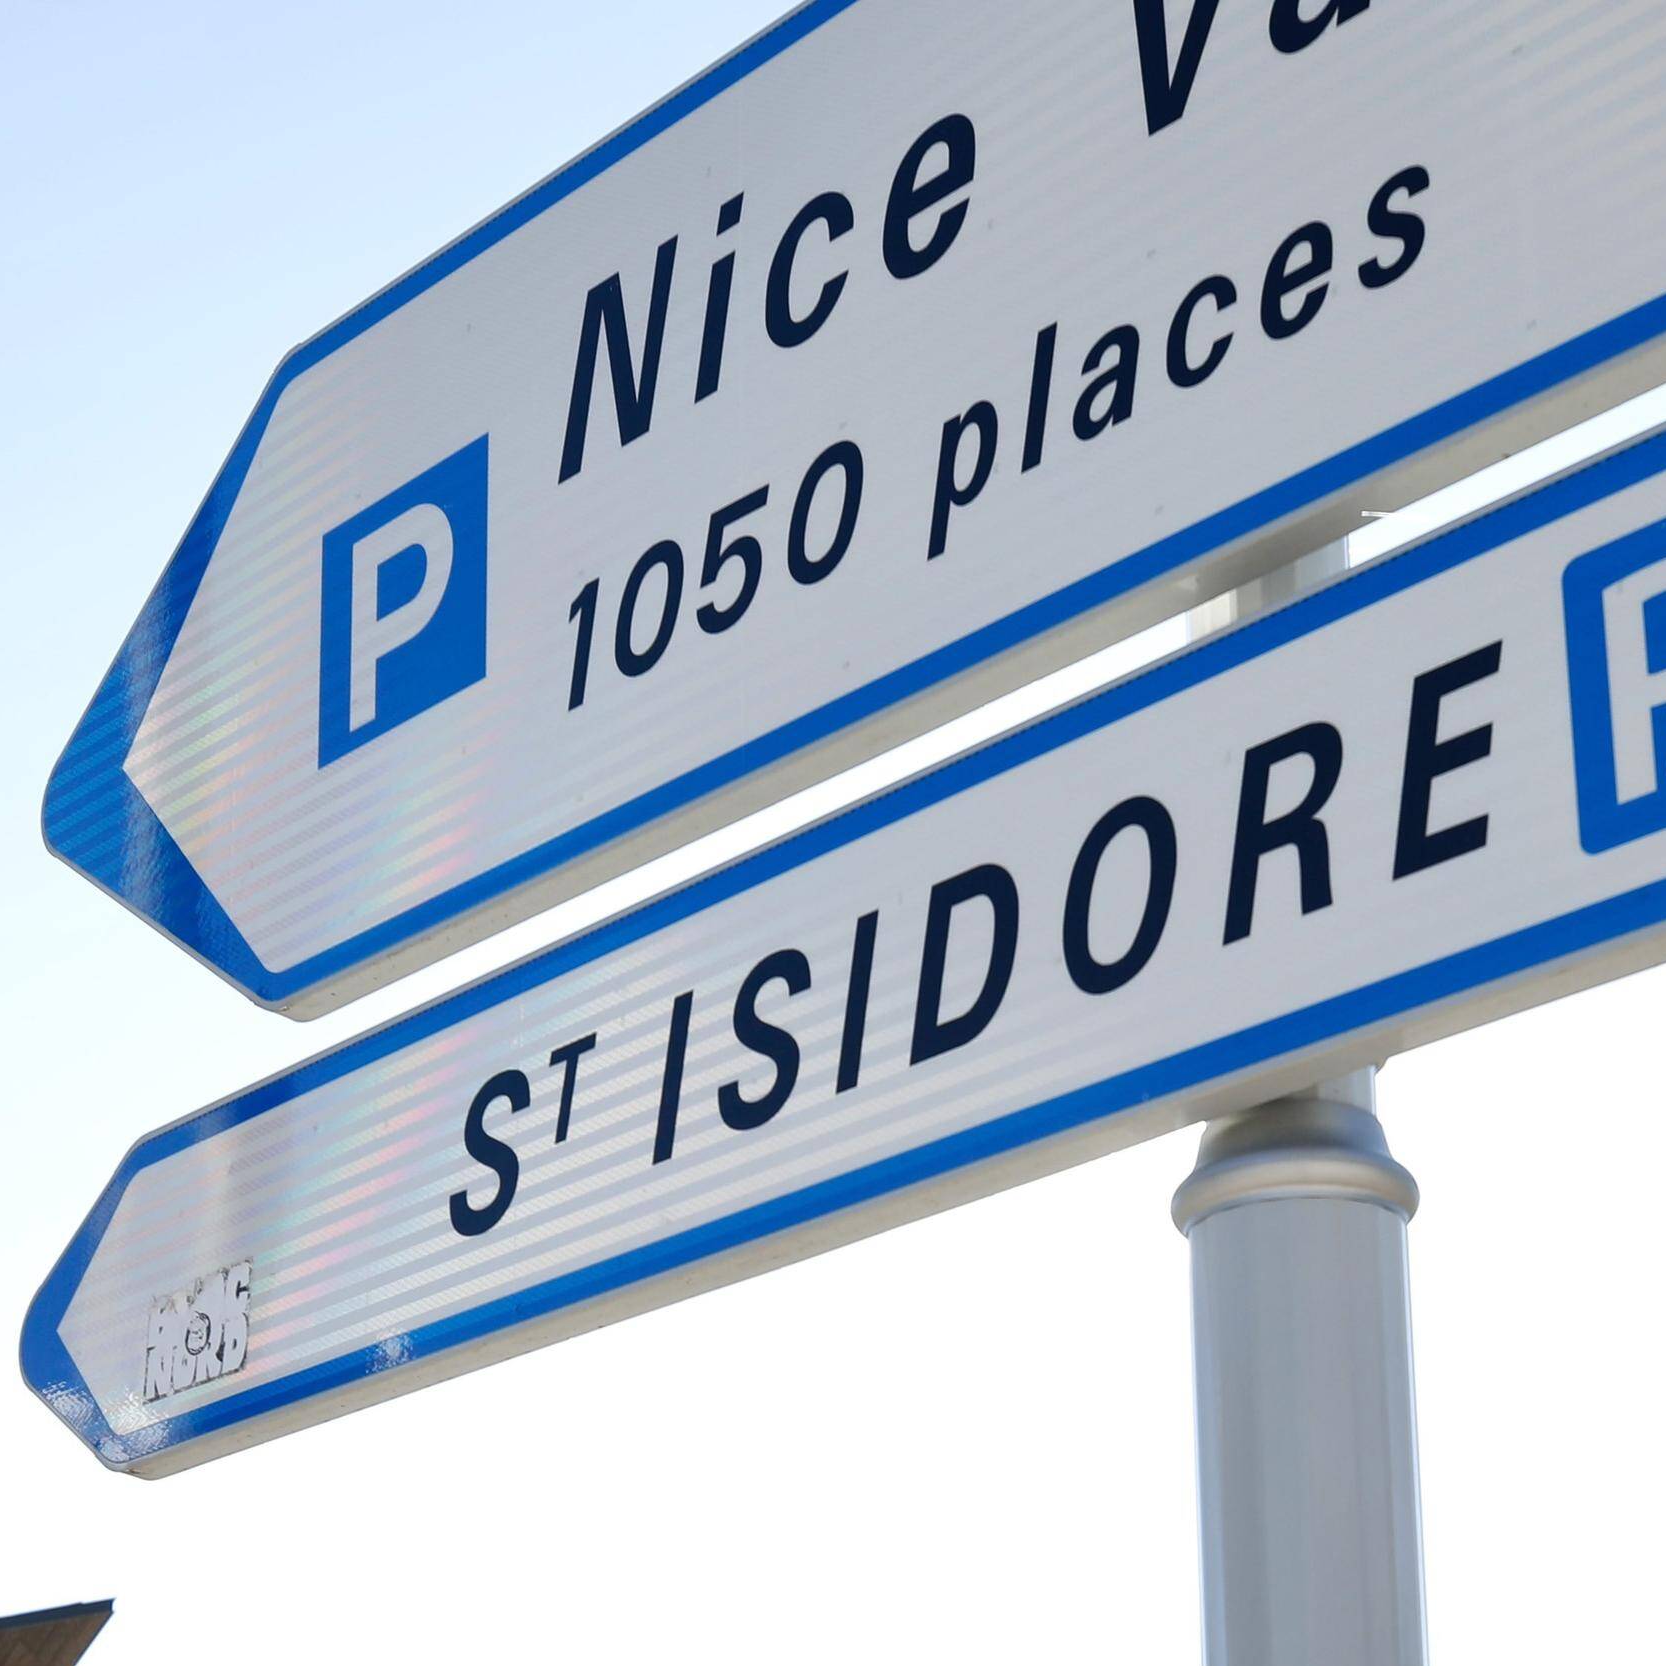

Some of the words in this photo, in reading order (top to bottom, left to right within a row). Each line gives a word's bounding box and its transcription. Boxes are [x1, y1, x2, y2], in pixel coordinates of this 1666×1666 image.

[558, 113, 976, 485] Nice
[568, 440, 864, 712] 1050
[927, 165, 1430, 562] places
[349, 503, 454, 733] P
[652, 639, 1503, 1166] ISIDORE
